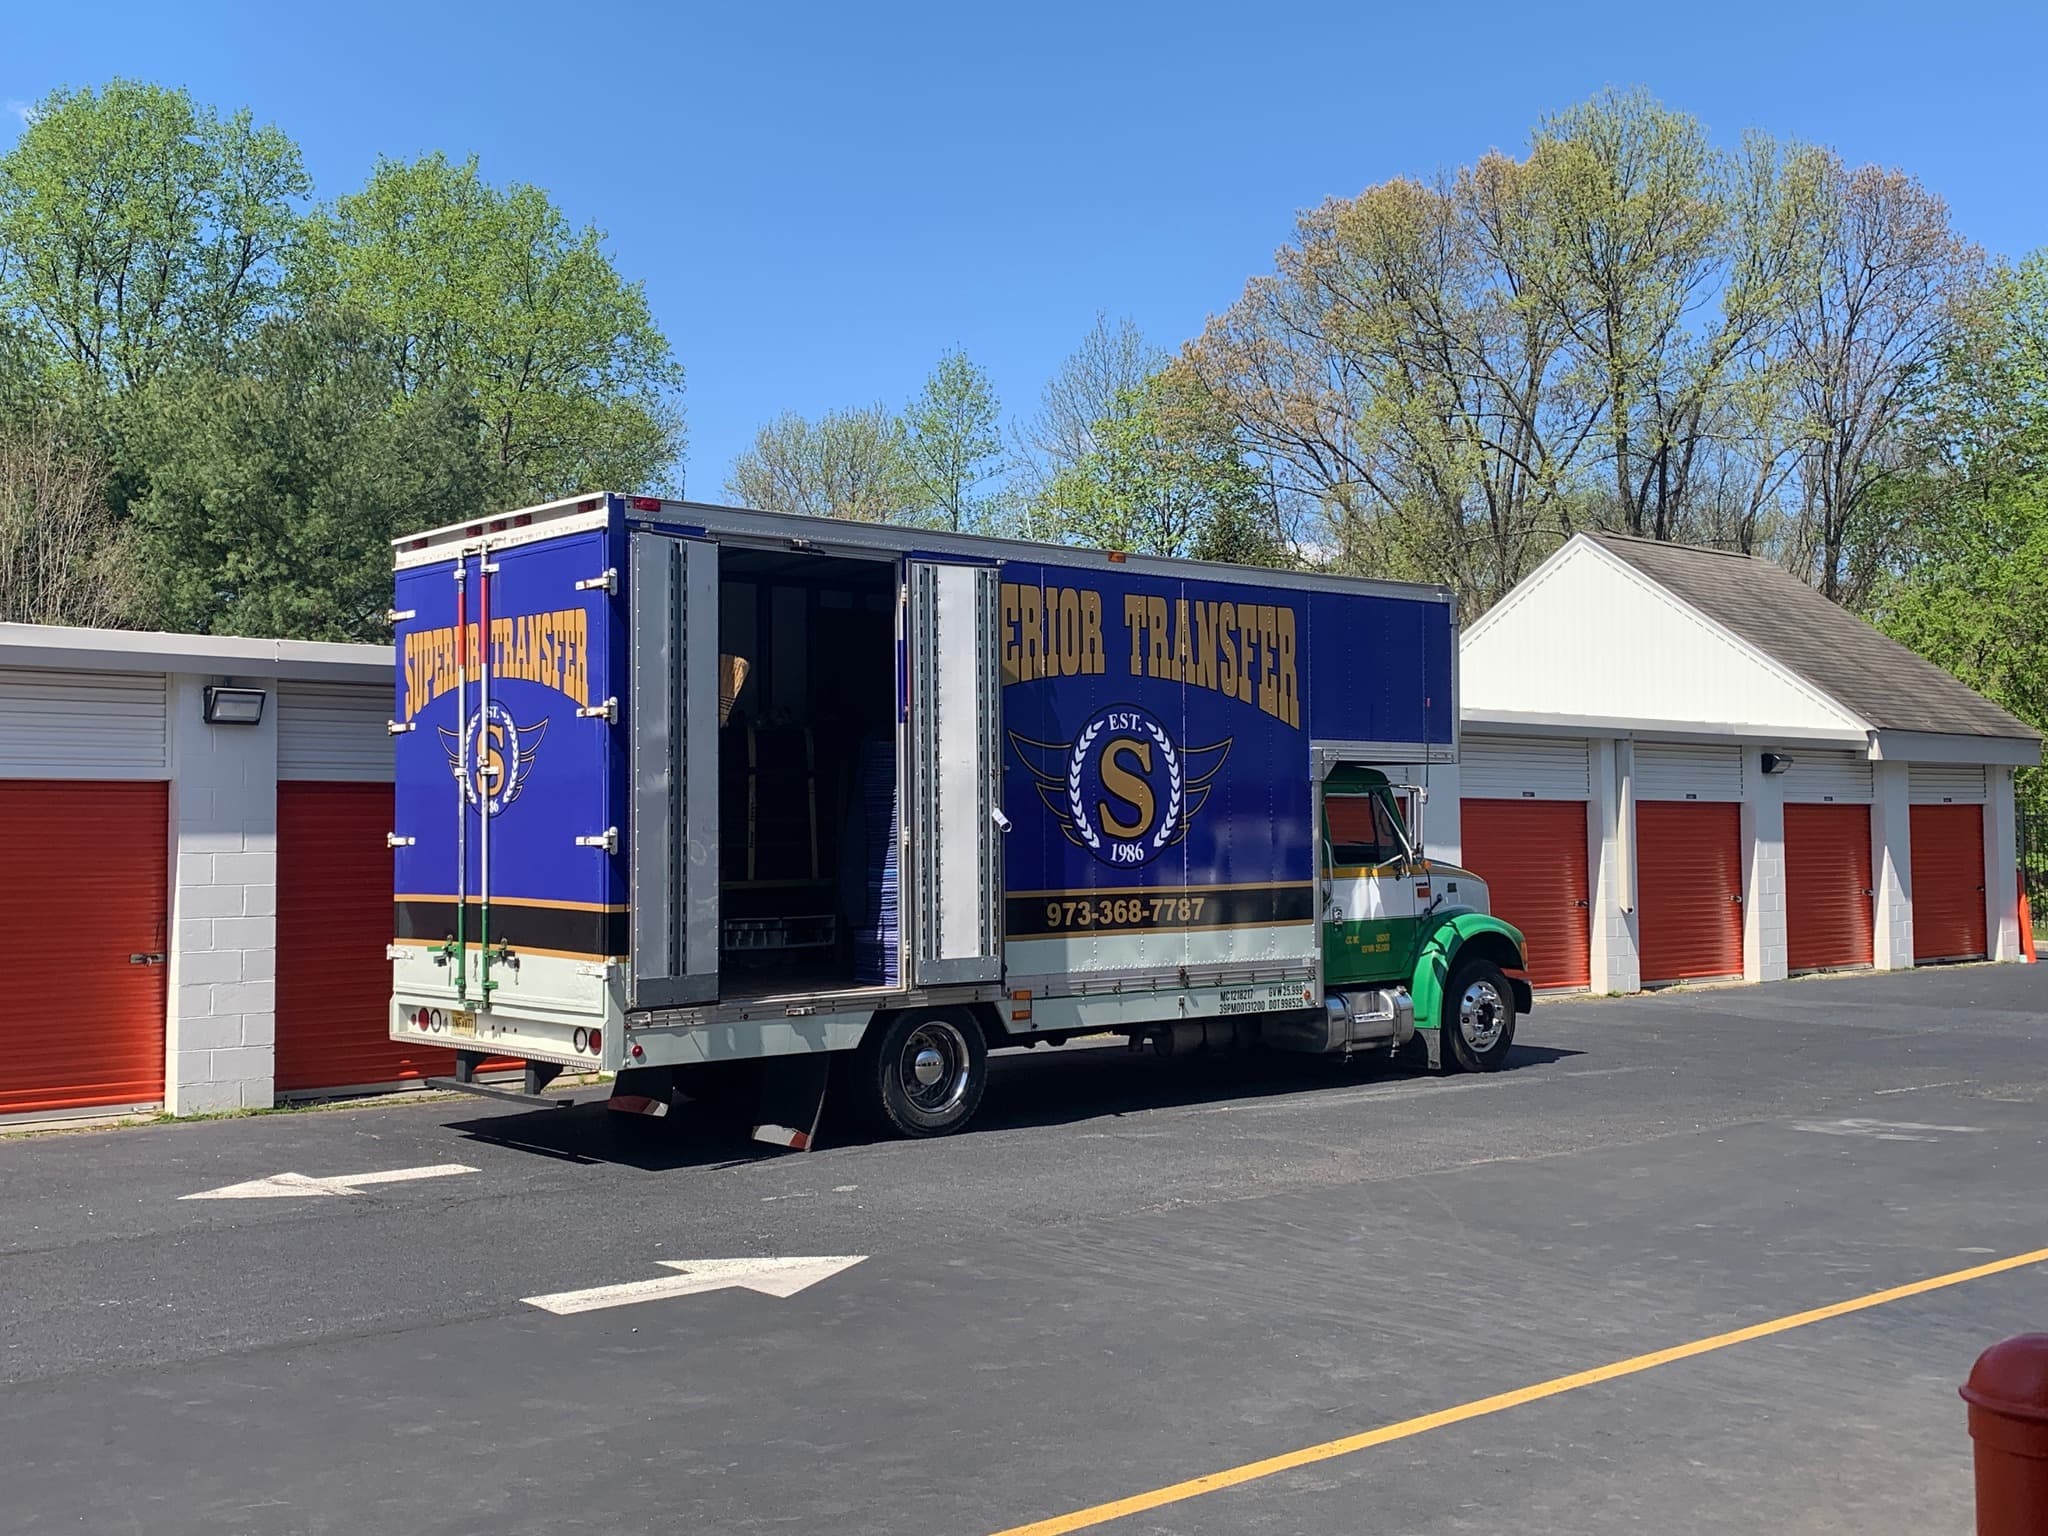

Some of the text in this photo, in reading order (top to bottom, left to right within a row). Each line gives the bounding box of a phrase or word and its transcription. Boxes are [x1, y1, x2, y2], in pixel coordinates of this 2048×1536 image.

[404, 608, 589, 723] SUPERIR TRANSFER
[1124, 594, 1300, 730] TRANSFER
[1109, 712, 1142, 733] EST.
[1100, 739, 1154, 838] S
[1110, 842, 1145, 863] 1986
[1046, 897, 1205, 927] 973-368-7787
